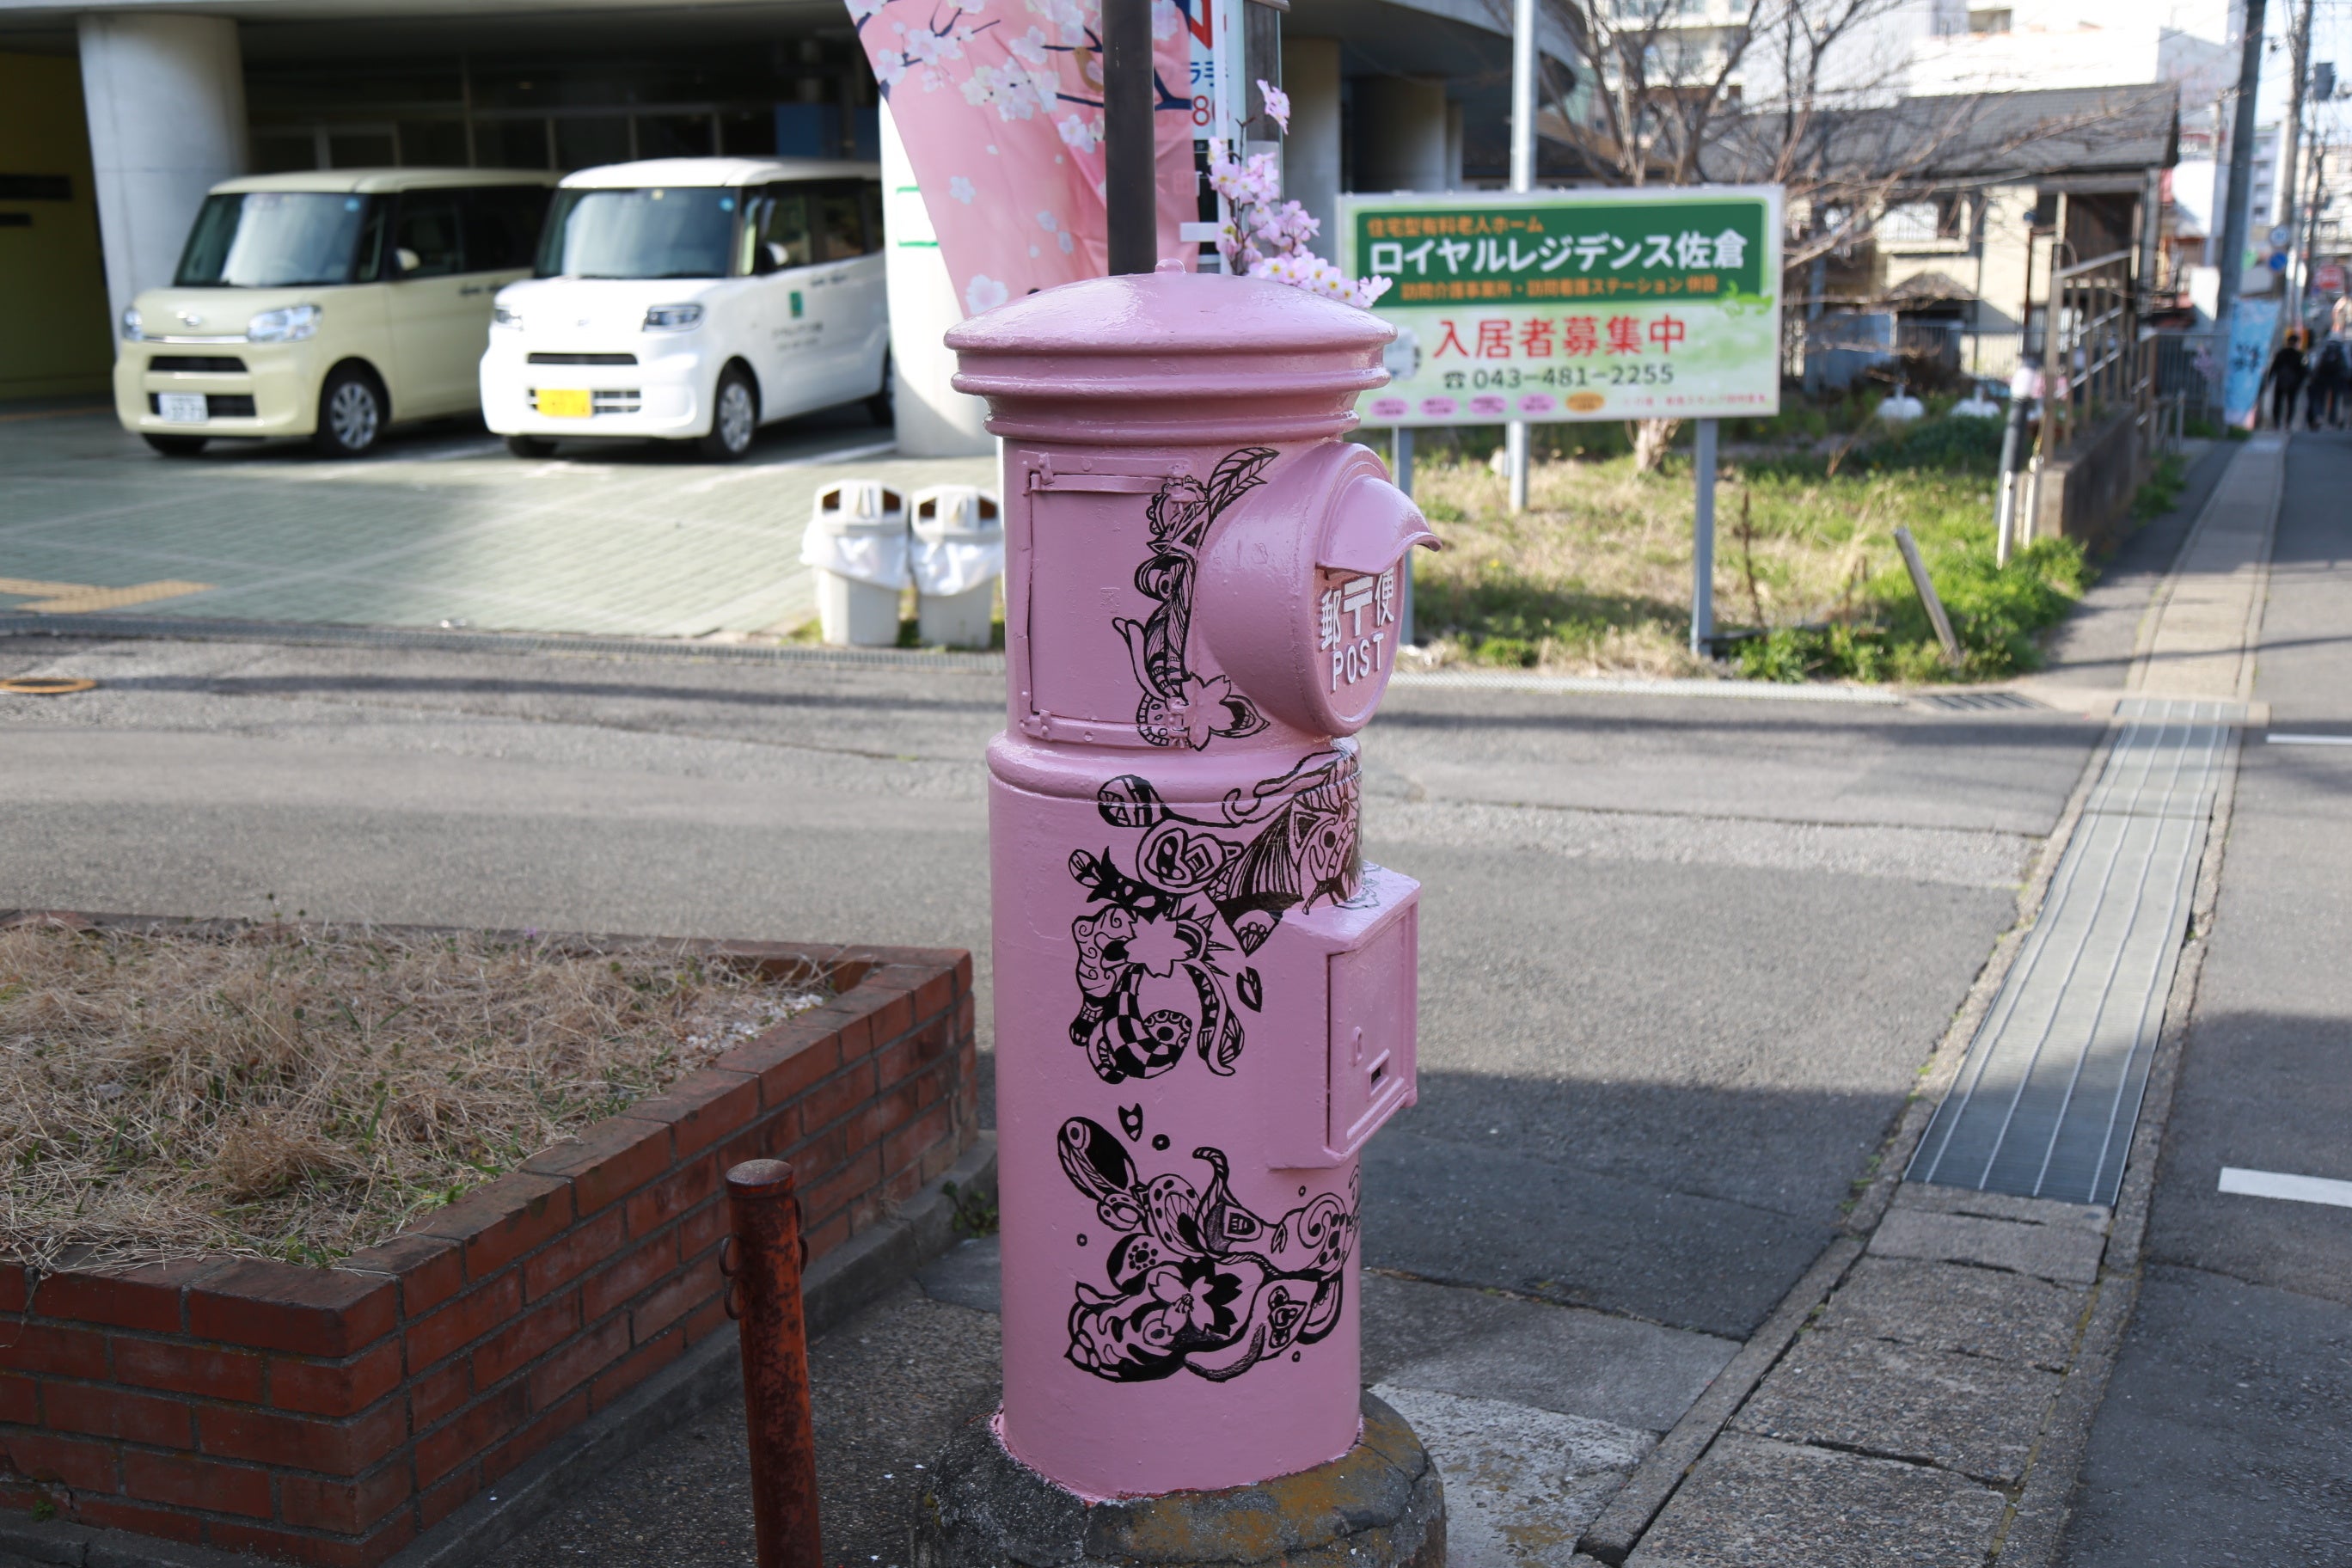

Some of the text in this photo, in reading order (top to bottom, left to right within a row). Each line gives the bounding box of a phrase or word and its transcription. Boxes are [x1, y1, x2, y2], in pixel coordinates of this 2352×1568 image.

[1370, 229, 1748, 274] ロイヤルレジデンス佐倉
[1433, 314, 1687, 359] 入居者募集中
[1332, 633, 1384, 691] POST
